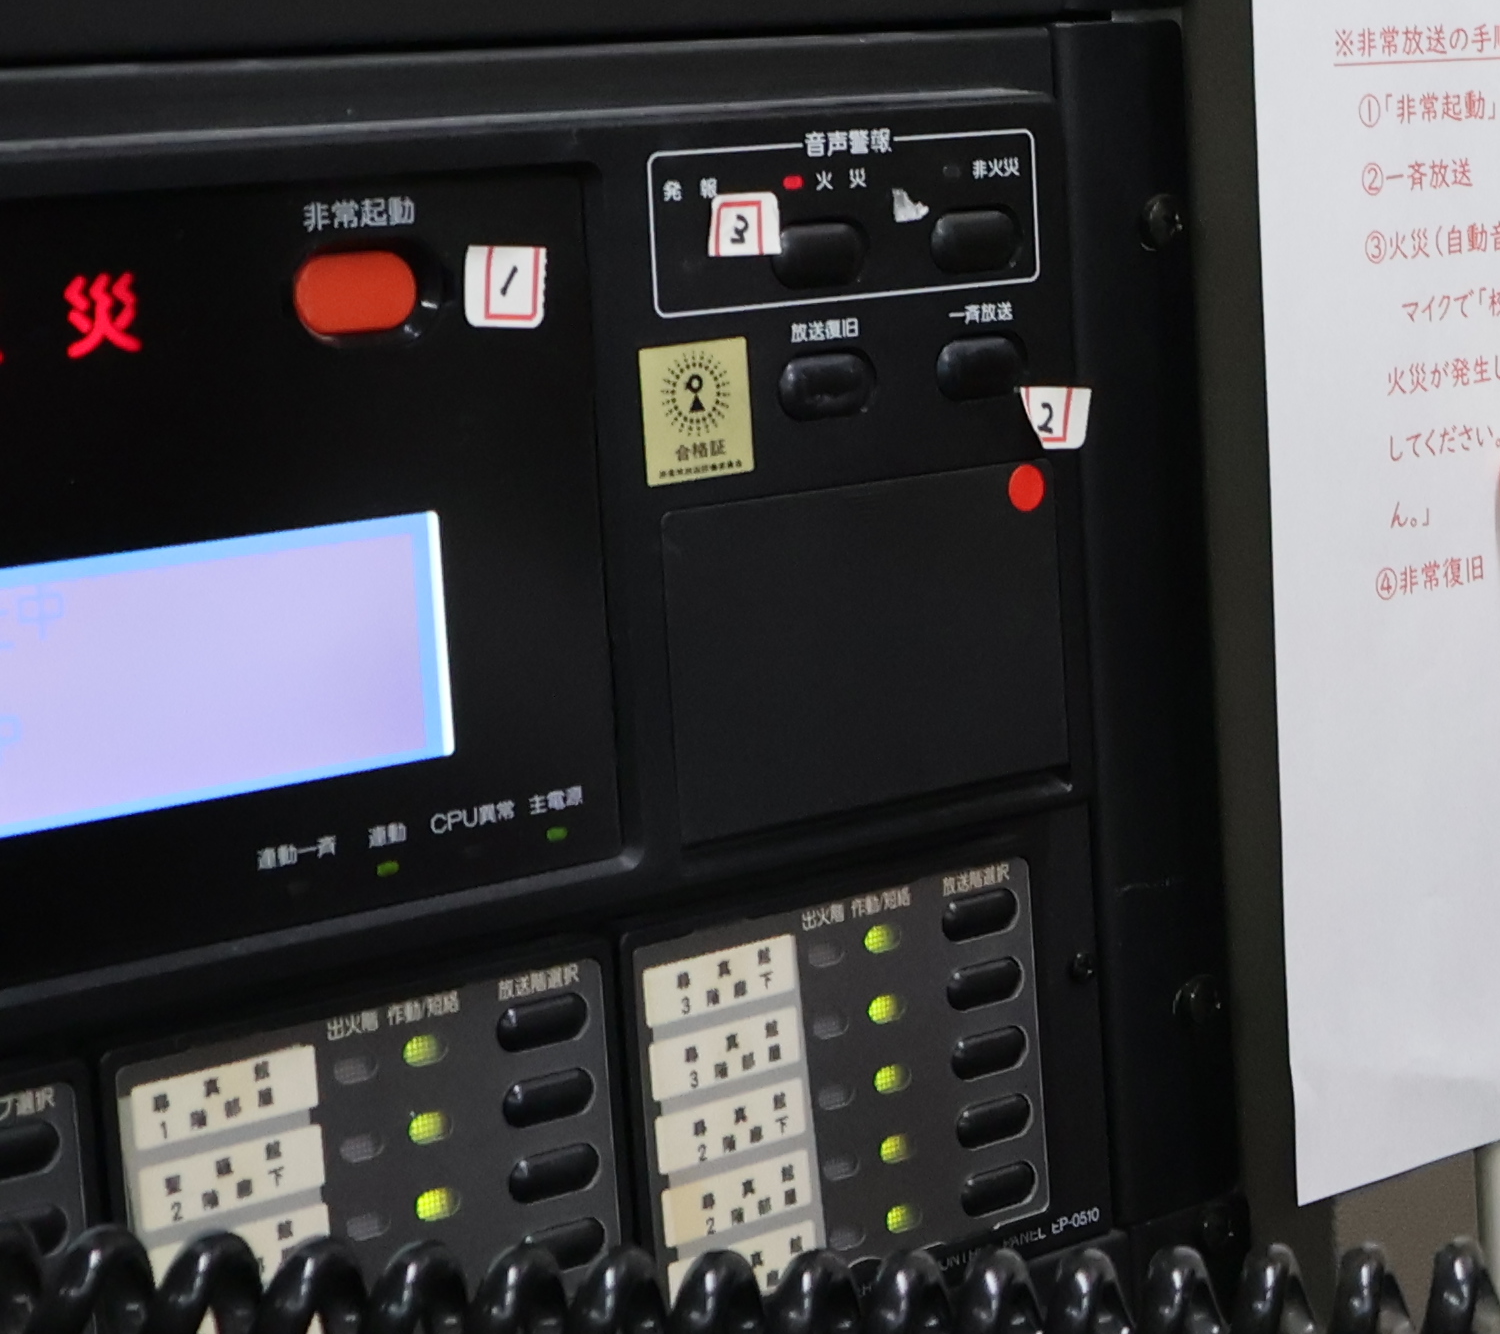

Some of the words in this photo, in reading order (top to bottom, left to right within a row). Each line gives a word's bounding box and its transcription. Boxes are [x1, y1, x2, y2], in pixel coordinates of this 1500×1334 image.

[804, 130, 892, 159] 音声警報
[972, 157, 1020, 179] 非火災
[1362, 157, 1473, 196] ②一斉放送
[303, 198, 414, 233] 非常起動
[730, 215, 750, 244] 3
[948, 303, 1014, 323] 一斉放送
[791, 319, 859, 343] 放送復旧
[1038, 403, 1054, 433] 2
[675, 440, 727, 461] 合格証
[1375, 554, 1484, 600] ④非常復旧
[528, 785, 584, 815] 主電源
[430, 799, 516, 837] CPU異常
[368, 821, 408, 849] 連動
[942, 864, 1010, 897] 放送階選択
[802, 903, 845, 931] 出火階
[497, 963, 580, 1001] 放送階選択
[326, 1013, 379, 1041] 出火階
[1052, 1207, 1100, 1235] EP-0510
